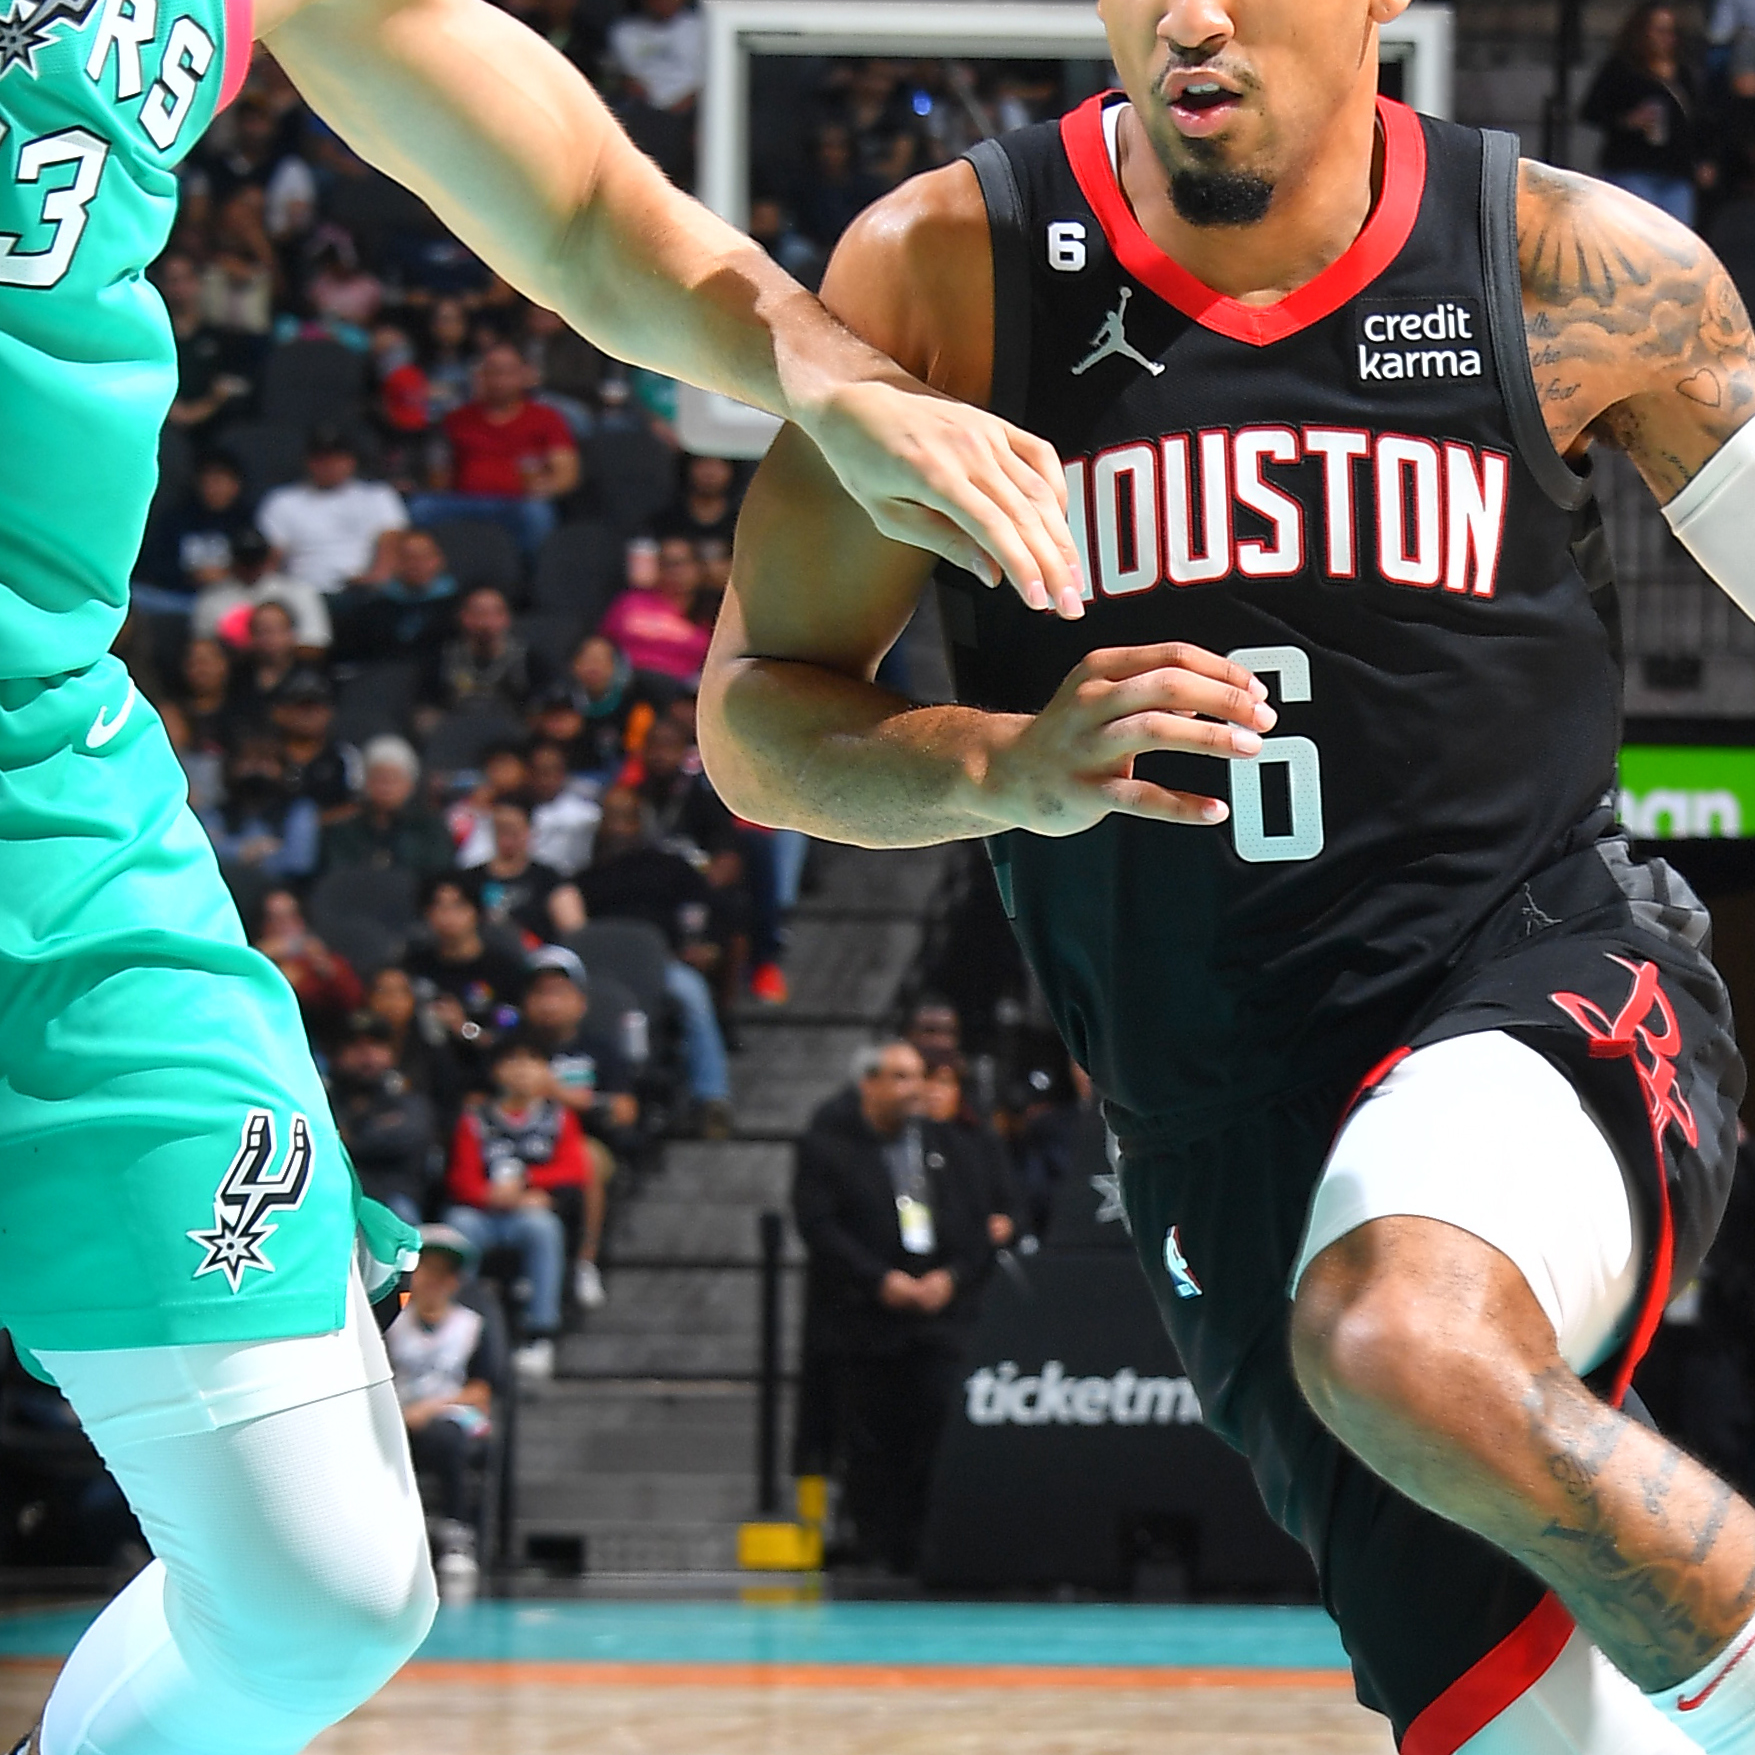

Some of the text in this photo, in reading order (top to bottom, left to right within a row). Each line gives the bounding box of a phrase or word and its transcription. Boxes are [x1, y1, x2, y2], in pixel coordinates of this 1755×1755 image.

[0, 113, 111, 290] 3
[1046, 221, 1087, 273] 6
[1363, 303, 1473, 342] credit
[1359, 342, 1482, 382] karma
[1227, 645, 1324, 863] 6
[966, 1360, 1203, 1426] ticketm
